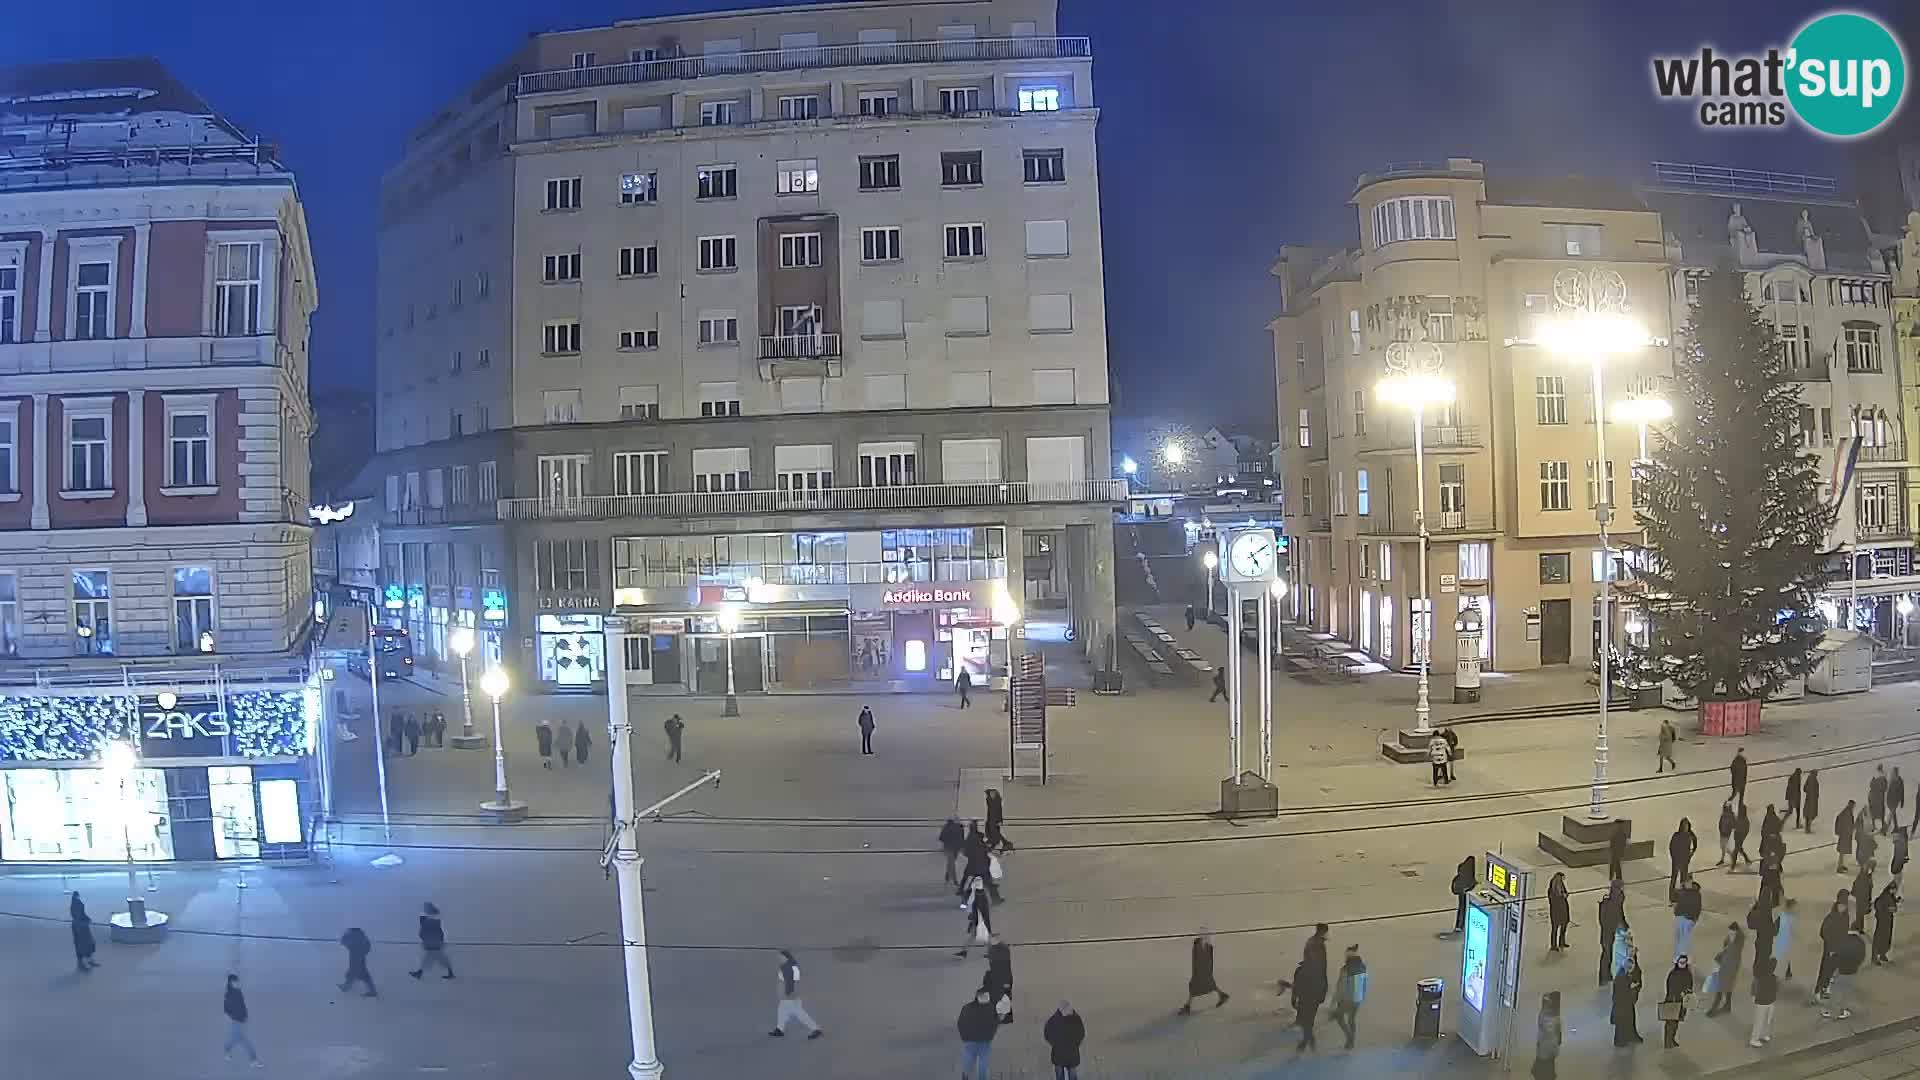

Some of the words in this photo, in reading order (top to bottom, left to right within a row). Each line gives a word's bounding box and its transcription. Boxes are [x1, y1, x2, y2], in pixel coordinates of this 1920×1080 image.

[883, 588, 933, 604] Addiko
[934, 586, 971, 602] Bank
[143, 711, 231, 739] ZAKS
